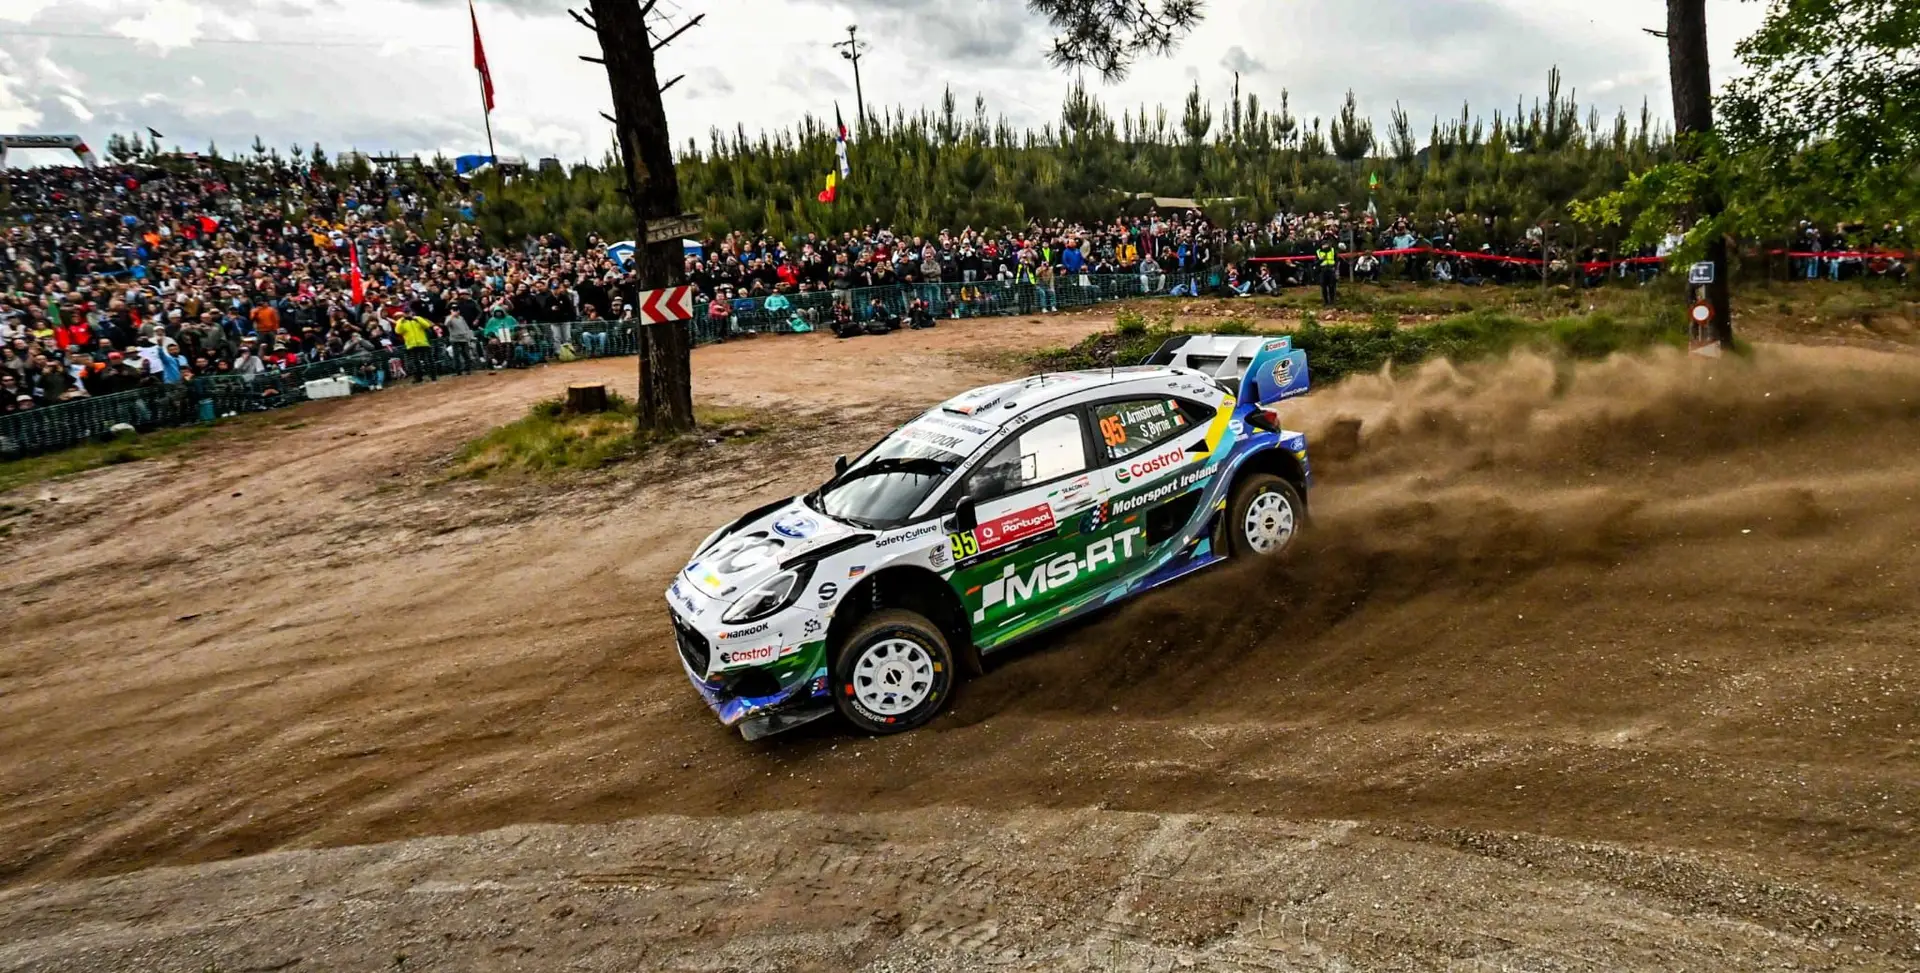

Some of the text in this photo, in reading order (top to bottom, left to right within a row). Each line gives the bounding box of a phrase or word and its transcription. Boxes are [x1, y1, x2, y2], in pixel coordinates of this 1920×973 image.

[1120, 403, 1166, 428] J Armstrong
[1149, 418, 1172, 438] Byrne
[1099, 415, 1128, 447] 95
[1130, 447, 1185, 478] Castrol
[1111, 462, 1219, 517] Motorsport Ireland
[1002, 511, 1052, 534] Portugal
[875, 524, 938, 549] SafetyCulture
[949, 531, 977, 560] 95
[1005, 526, 1140, 608] MS-RT
[731, 645, 773, 662] Castrol
